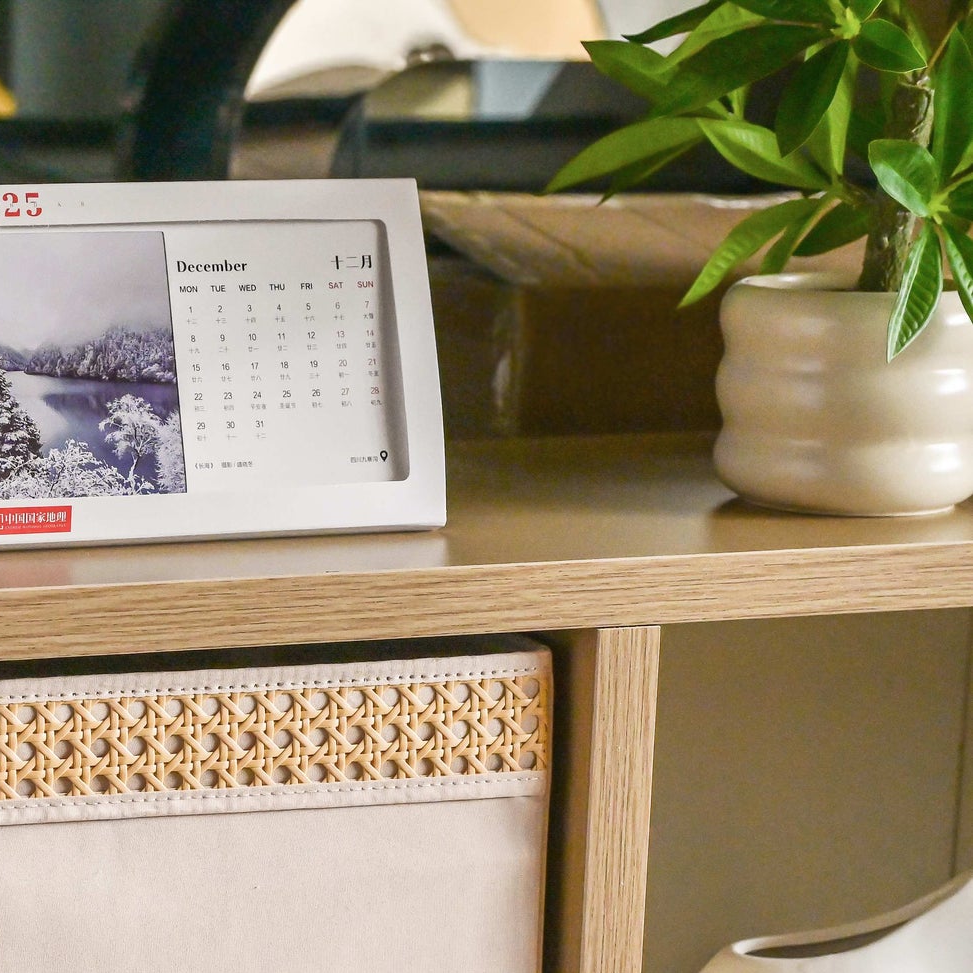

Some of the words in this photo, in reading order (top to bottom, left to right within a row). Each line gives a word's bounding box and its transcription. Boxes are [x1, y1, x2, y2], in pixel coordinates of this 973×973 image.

[176, 259, 248, 273] December
[330, 254, 372, 270] 十二月
[179, 285, 198, 293] MON
[210, 284, 227, 293] TUE
[238, 283, 257, 292] WED
[269, 283, 286, 291] THU
[300, 282, 314, 290] FRI
[328, 281, 344, 290] SAT
[357, 280, 374, 289] SUN
[248, 332, 257, 342] 10
[277, 332, 286, 340] 11
[307, 331, 316, 339] 12
[336, 330, 346, 338] 13
[366, 329, 375, 337] 14
[192, 363, 201, 372] 15
[221, 362, 231, 371] 16
[250, 361, 259, 370] 17
[280, 360, 289, 369] 18
[309, 359, 319, 368] 19
[338, 358, 348, 368] 20
[367, 358, 377, 366] 21
[194, 392, 203, 401] 22
[223, 391, 233, 400] 23
[252, 391, 262, 399] 24
[282, 389, 292, 398] 25
[311, 388, 321, 397] 26
[341, 387, 350, 396] 27
[370, 386, 380, 395] 28
[196, 421, 206, 430] 29
[226, 420, 236, 429] 30
[255, 420, 264, 428] 31
